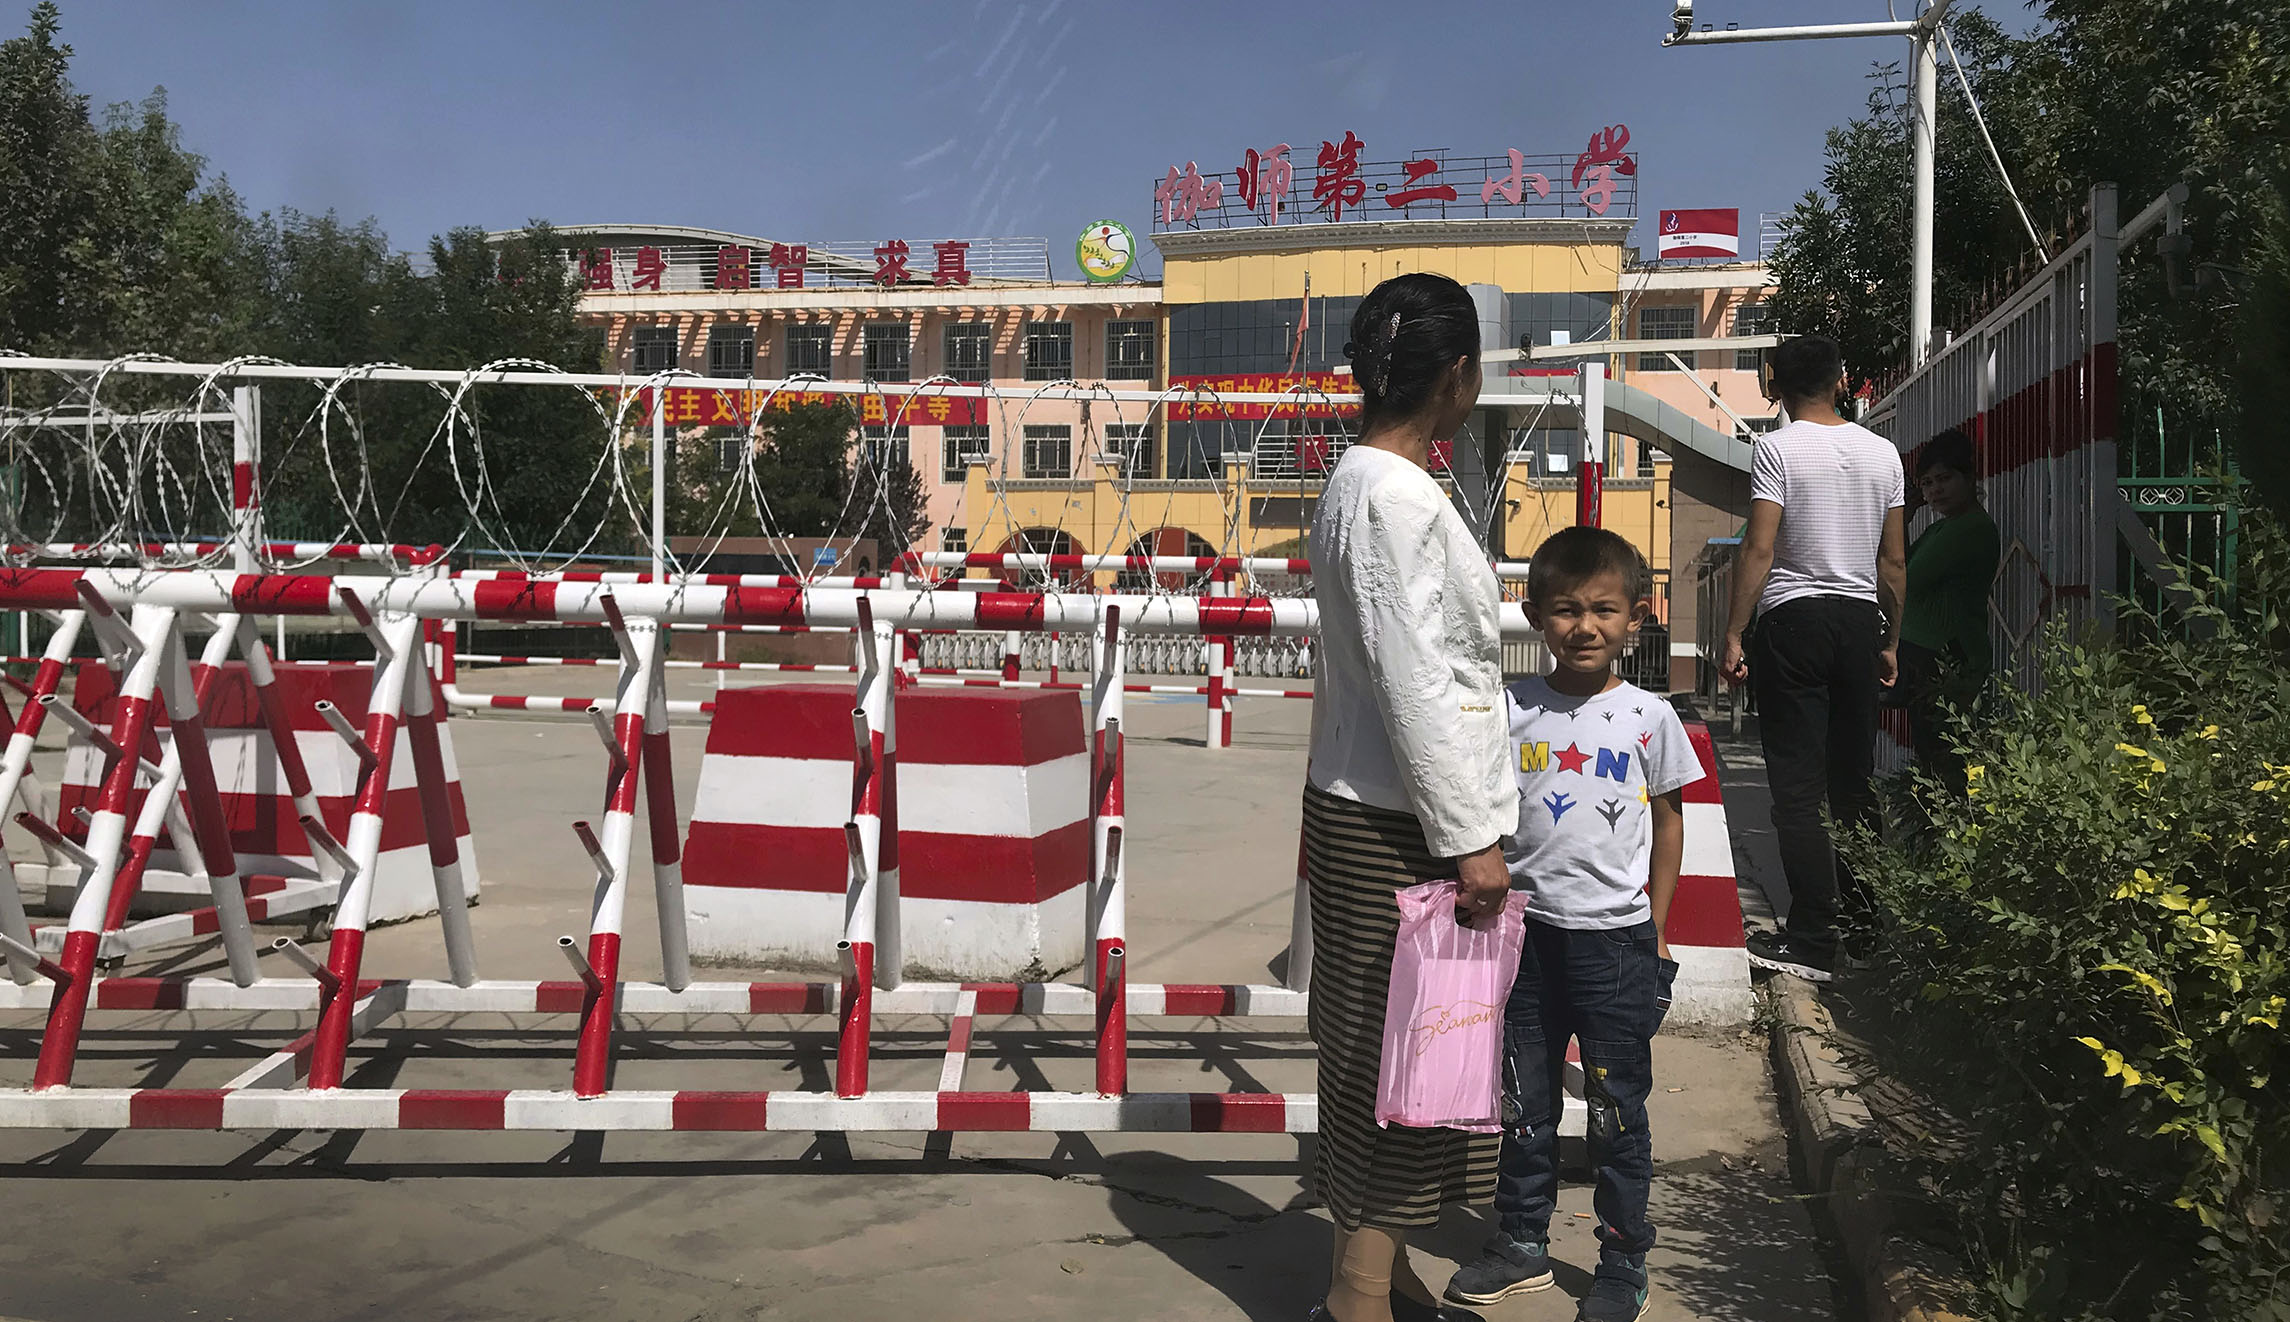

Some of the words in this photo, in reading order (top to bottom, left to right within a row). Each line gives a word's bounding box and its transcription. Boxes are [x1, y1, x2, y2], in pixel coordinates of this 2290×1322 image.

[1156, 124, 1635, 225] 伽师第二小学
[713, 243, 809, 291] 启智
[873, 239, 971, 286] 求真
